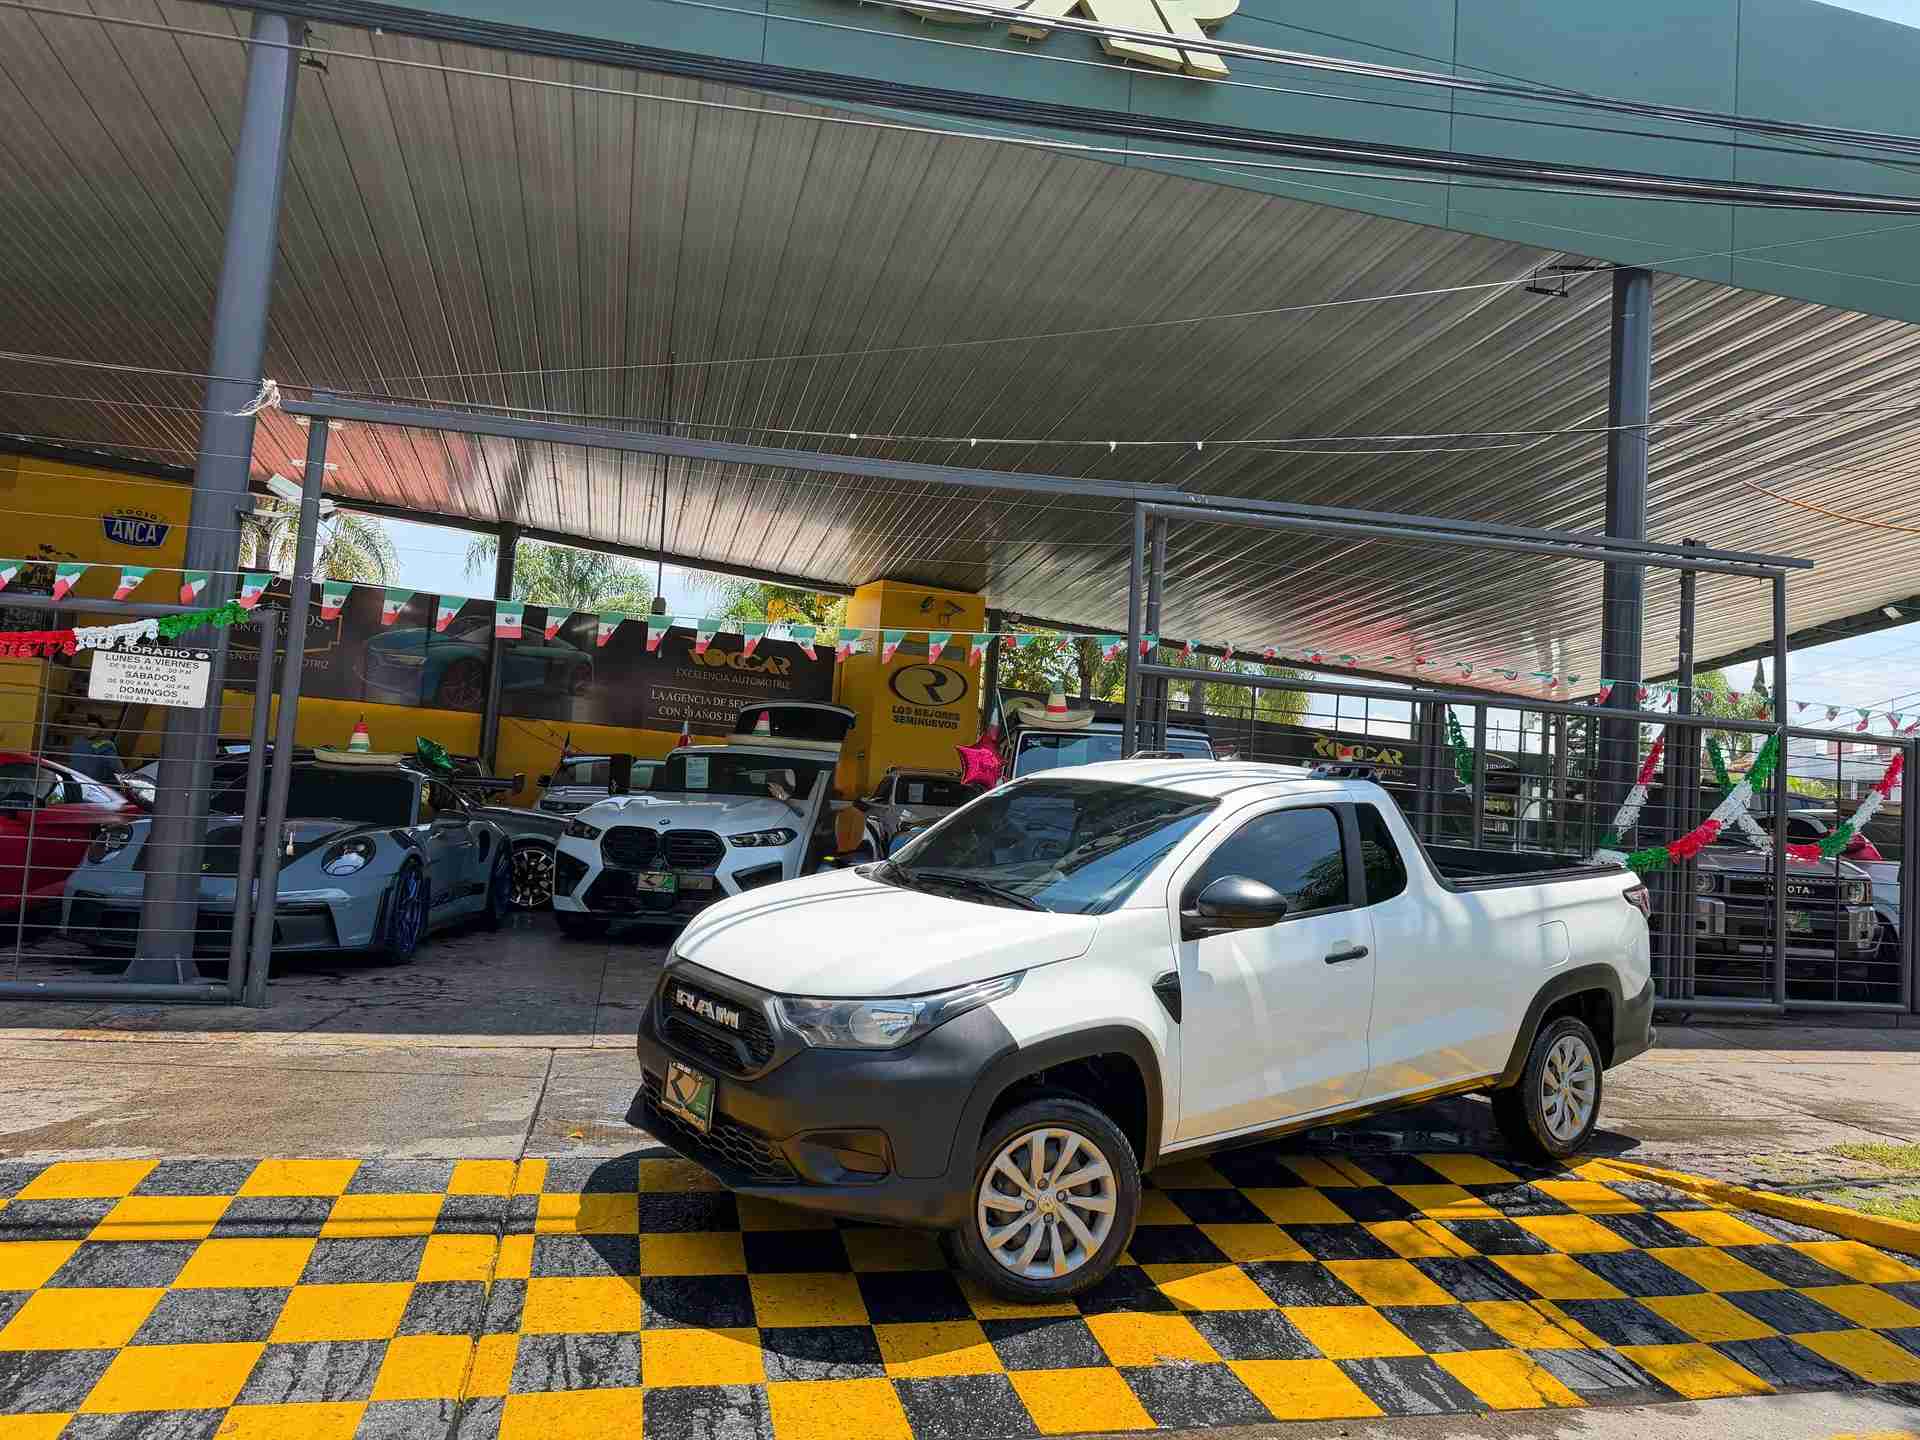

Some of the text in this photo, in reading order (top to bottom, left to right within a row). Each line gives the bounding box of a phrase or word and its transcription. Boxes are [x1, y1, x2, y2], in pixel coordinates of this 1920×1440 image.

[112, 520, 157, 544] ANCA
[117, 644, 191, 659] HORARIO
[105, 653, 141, 664] LUNES
[154, 658, 200, 670] VIERNES
[125, 670, 177, 683] SABADOS
[118, 685, 178, 698] DOMINGOS
[649, 687, 665, 701] LA
[666, 690, 712, 705] AGENCIA
[713, 695, 727, 706] DE
[658, 705, 680, 717] CON
[892, 705, 960, 720] LOS MEJORES
[676, 988, 740, 1030] RAM
